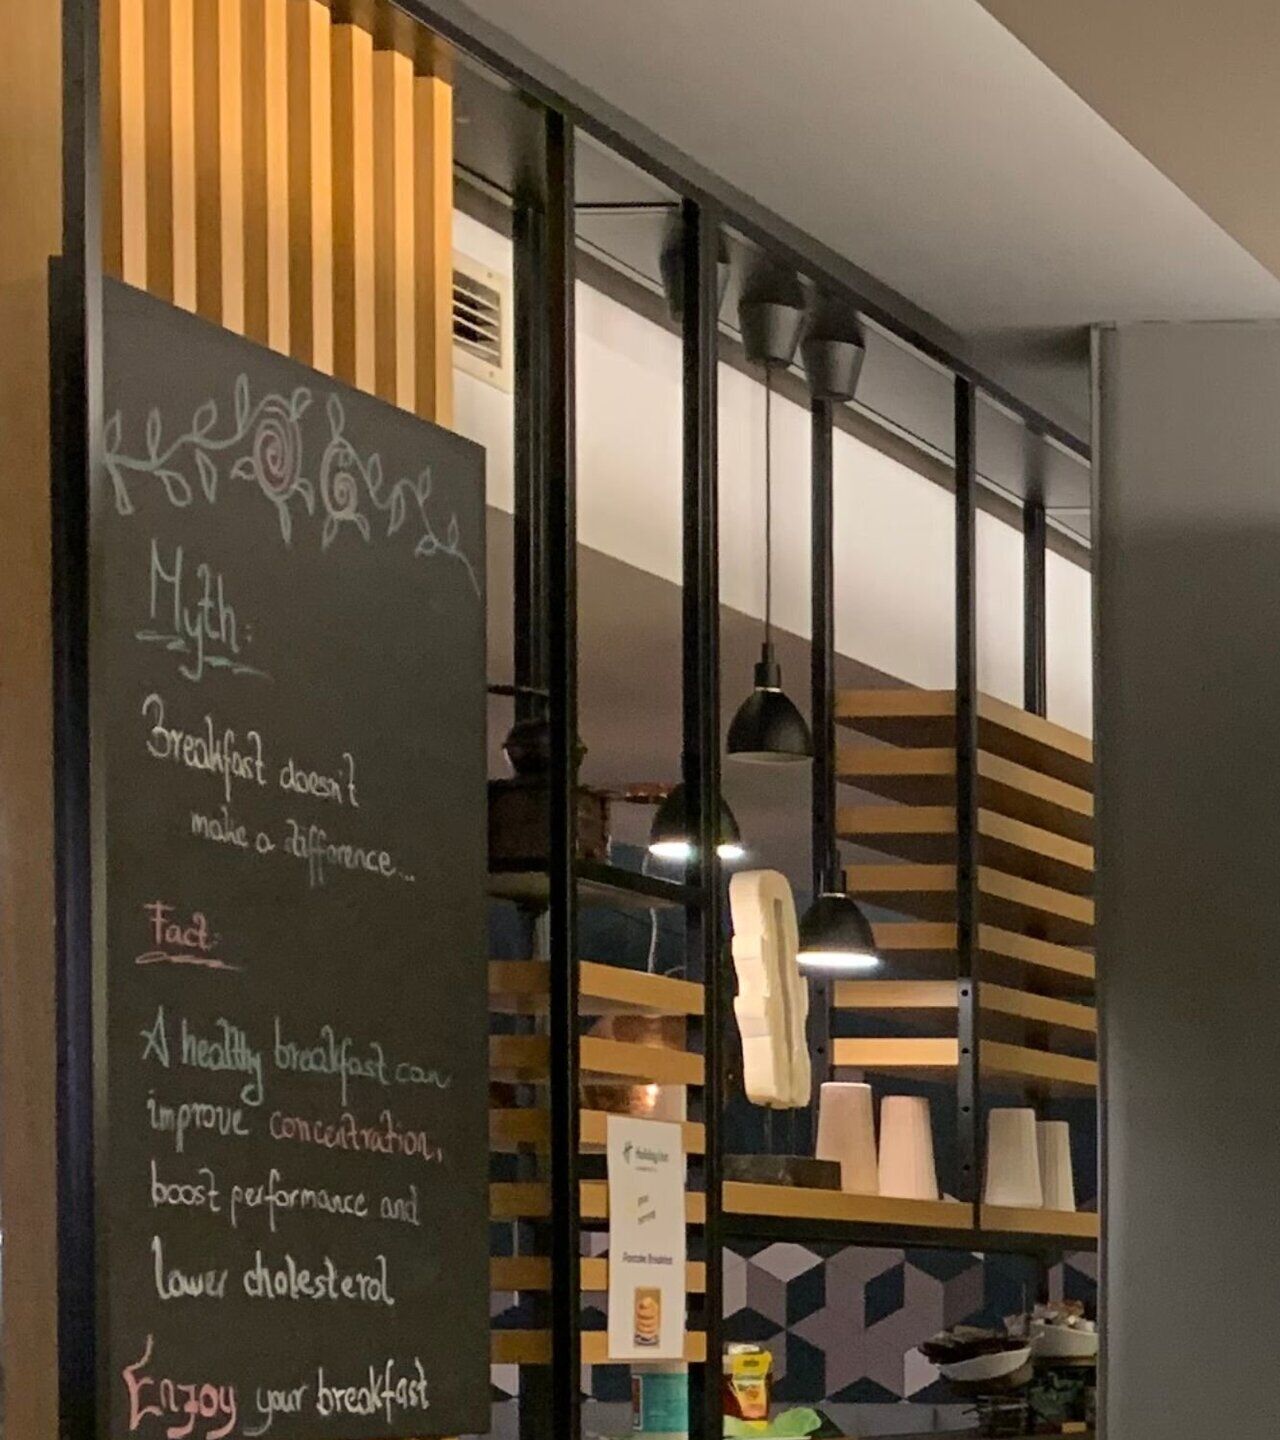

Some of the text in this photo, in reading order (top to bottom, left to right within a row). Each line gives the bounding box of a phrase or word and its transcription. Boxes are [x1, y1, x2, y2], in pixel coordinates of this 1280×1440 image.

[142, 693, 267, 801] Breakfast
[192, 806, 248, 848] make
[256, 832, 275, 851] a
[140, 1005, 450, 1105] A healthy breakfast can
[147, 1091, 249, 1152] improve
[151, 1160, 421, 1232] boost performance and
[152, 1236, 395, 1306] lower cholesterol
[122, 1333, 429, 1440] Enjoy your breakfast
